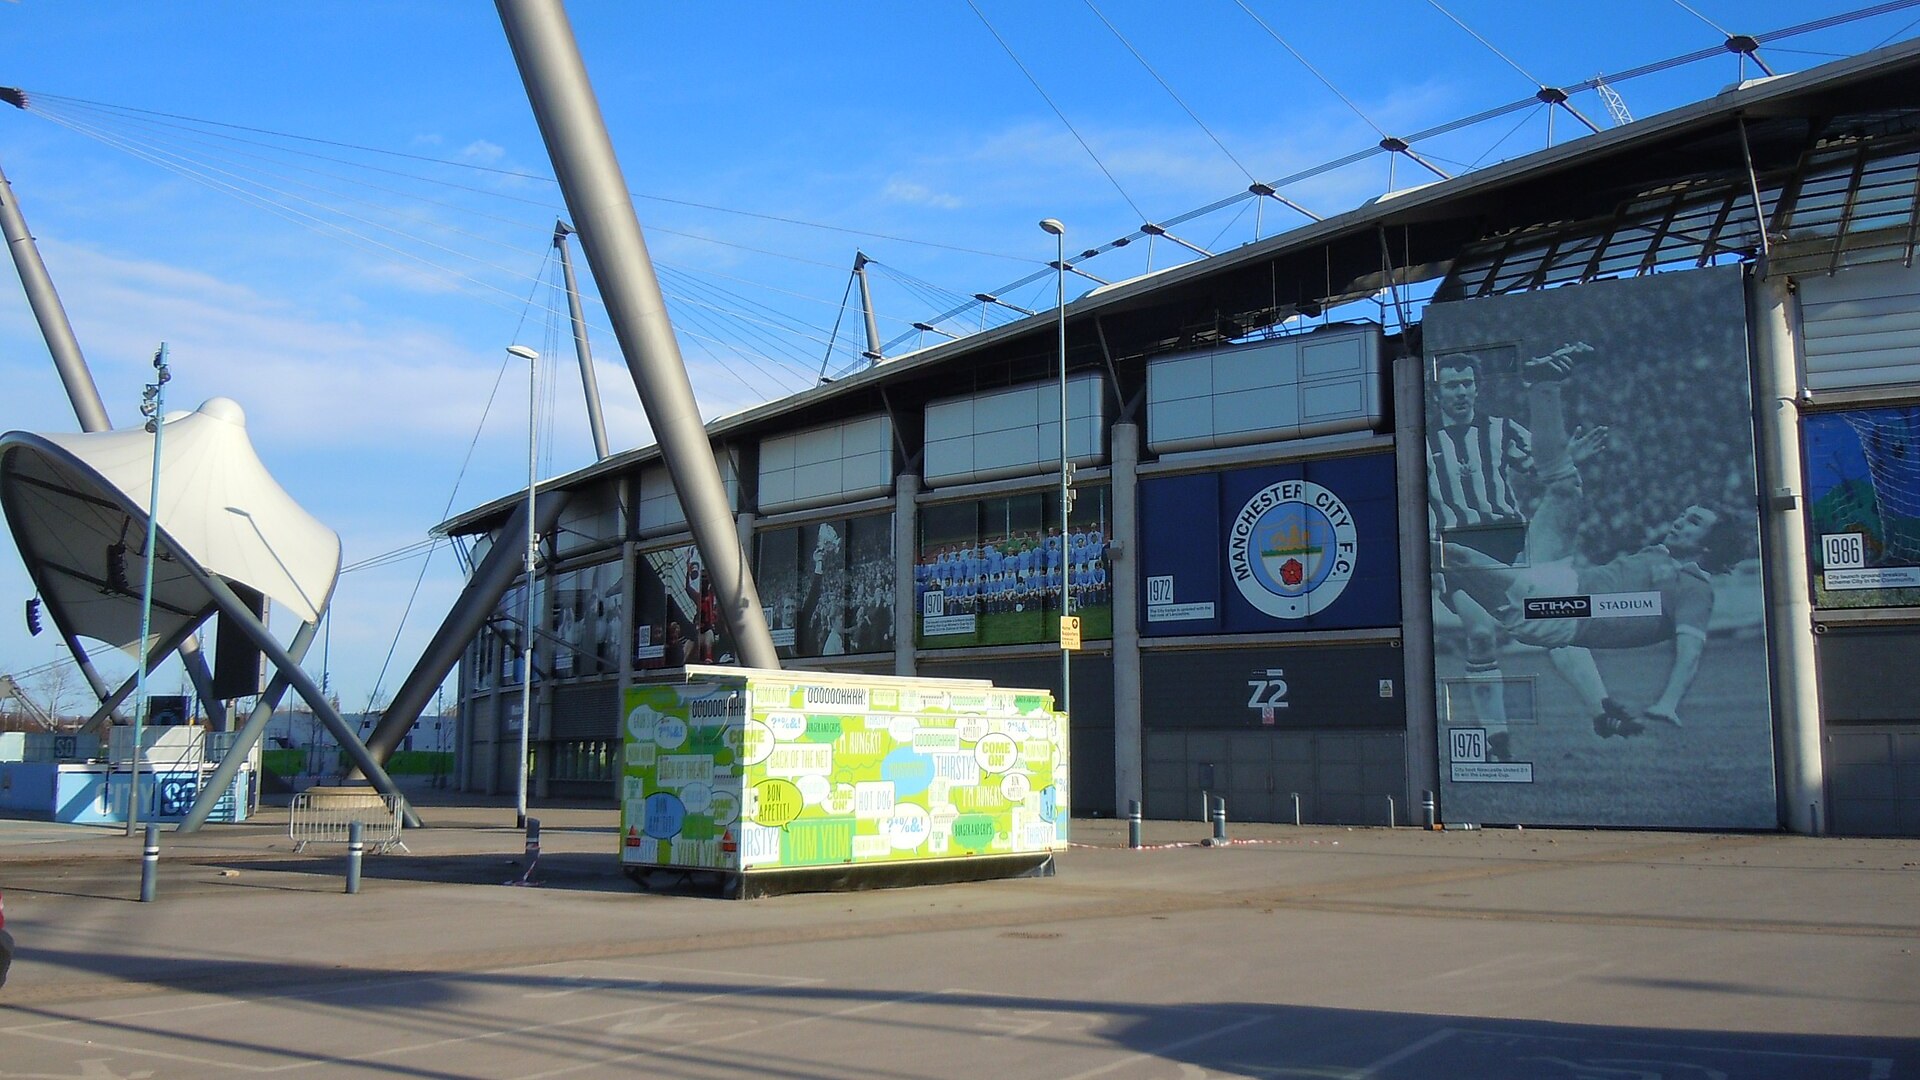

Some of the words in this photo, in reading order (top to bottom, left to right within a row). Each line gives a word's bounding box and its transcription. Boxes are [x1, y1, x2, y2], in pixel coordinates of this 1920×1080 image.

[1233, 484, 1303, 582] MANCHESTER
[1316, 492, 1350, 528] CITY
[1333, 542, 1354, 577] F.C.
[1826, 538, 1860, 565] 1986
[1149, 579, 1171, 601] 1972
[925, 594, 942, 614] 1970
[1528, 600, 1587, 611] ETIHAD
[1599, 600, 1654, 610] STADIUM
[1248, 680, 1289, 707] Z2
[982, 742, 1011, 754] COME
[1453, 733, 1481, 758] 1976
[770, 751, 790, 769] BACK
[791, 751, 800, 768] OF
[801, 750, 816, 768] THE
[816, 750, 829, 767] NET
[936, 755, 976, 780] THIRSTY?
[988, 755, 1004, 766] ON!
[95, 783, 154, 815] CITY
[767, 784, 782, 801] BON
[828, 789, 853, 800] COME
[858, 791, 873, 811] HOT
[876, 790, 892, 810] DOG
[758, 802, 790, 822] APPETIT!
[832, 800, 847, 811] ON!
[790, 827, 818, 861] YUM
[821, 824, 850, 859] YUM
